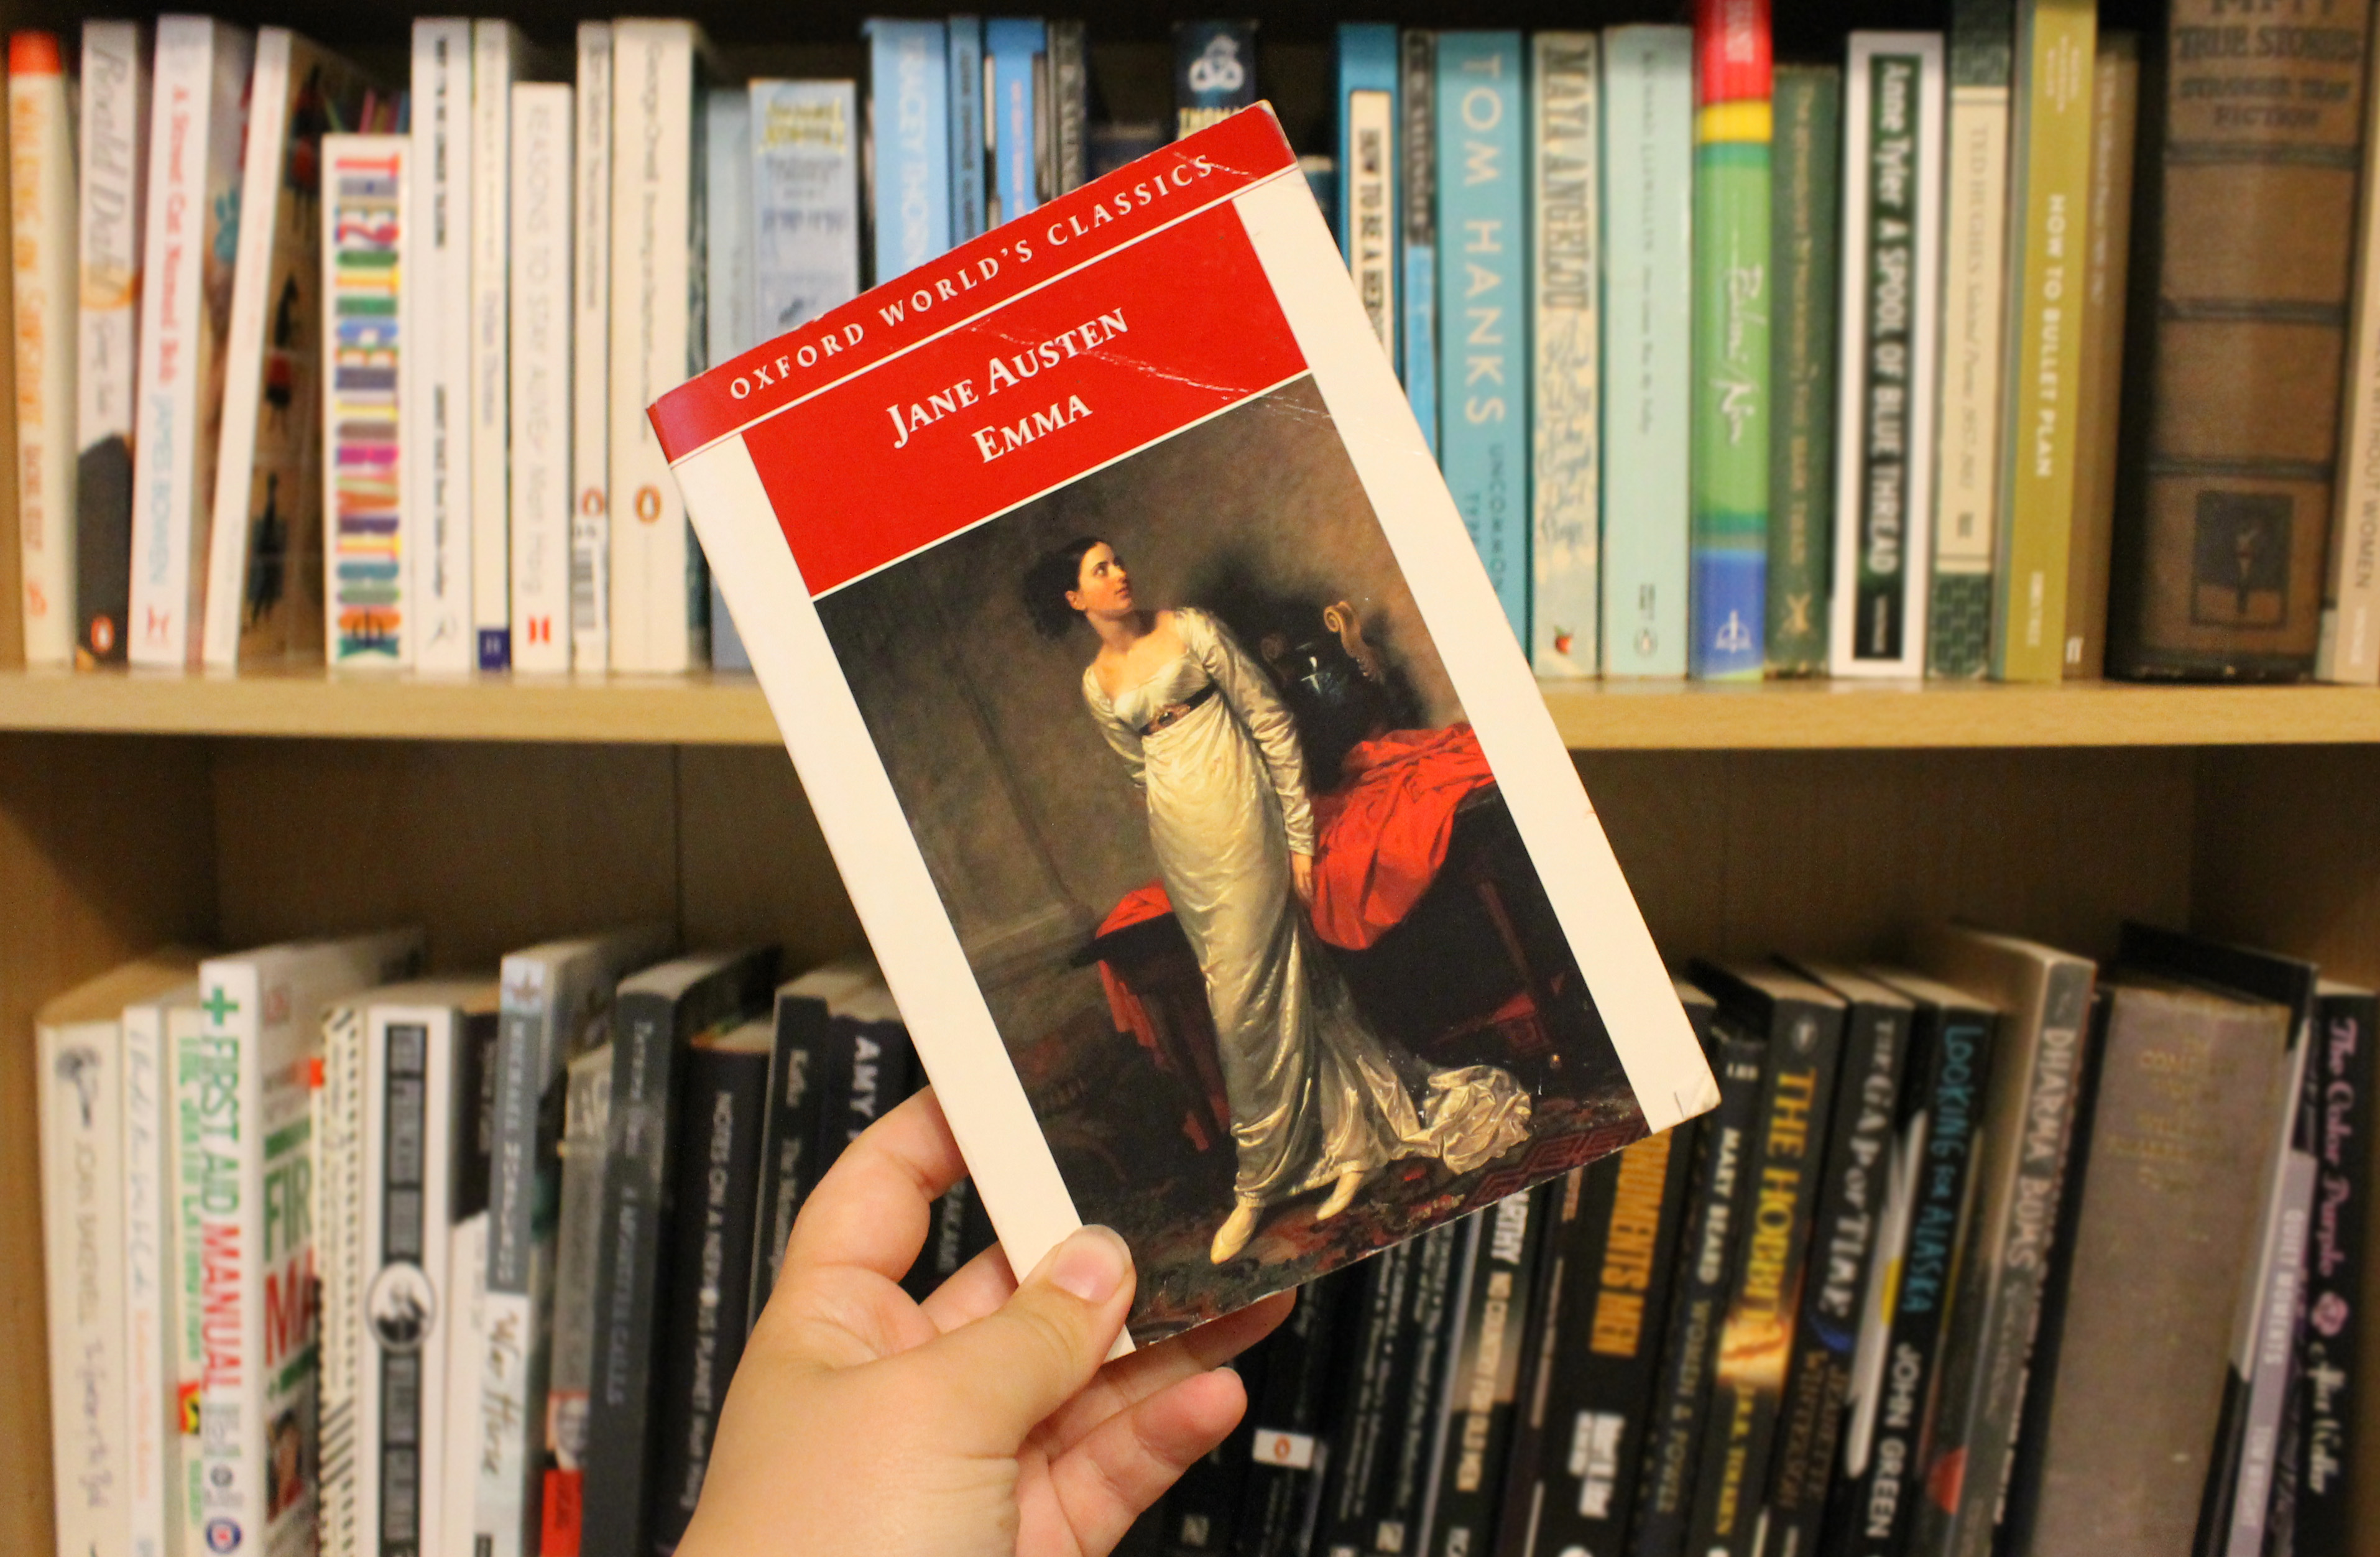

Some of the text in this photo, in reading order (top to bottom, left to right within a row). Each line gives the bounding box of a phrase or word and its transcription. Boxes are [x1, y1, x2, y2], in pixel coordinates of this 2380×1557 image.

[169, 113, 190, 183] Street
[1543, 46, 1590, 313] MAYA ANGELOU
[1875, 62, 1911, 208] Anne Tyler
[167, 192, 187, 236] Cat
[730, 154, 1214, 399] OXFORD WORLD'S CLASSICS
[1462, 53, 1505, 425] TOM HANKS
[886, 307, 1128, 449] JANE AUSTEN
[1868, 218, 1907, 576] A SPOOL OF BLUE THREAD
[2036, 193, 2065, 478] HOW TO BULLET PLAN
[971, 394, 1093, 463] EMMA
[2356, 500, 2378, 589] WOMEN
[849, 1036, 881, 1118] AMY
[1873, 1019, 1894, 1070] THE
[1929, 1026, 1985, 1158] LOOKING
[2025, 1028, 2077, 1162] DHARMA
[1850, 1074, 1893, 1167] GAP
[2315, 1018, 2358, 1278] The Color Purple
[201, 1036, 242, 1392] FIRST AID MANUAL
[1490, 1190, 1529, 1265] ARTHY
[1601, 1132, 1670, 1291] ONUMENTS
[1697, 1126, 1741, 1285] MARY BEARD
[1739, 1067, 1816, 1324] THE HOBBIT
[1819, 1213, 1871, 1318] TIME
[1903, 1204, 1953, 1312] ALASKA
[2005, 1176, 2051, 1272] BUMS
[1592, 1291, 1645, 1357] MEN
[2263, 1208, 2305, 1365] QUIET MOMENTS
[1656, 1300, 1713, 1513] WOMEN & POWER
[1865, 1343, 1922, 1537] JOHN GREEN
